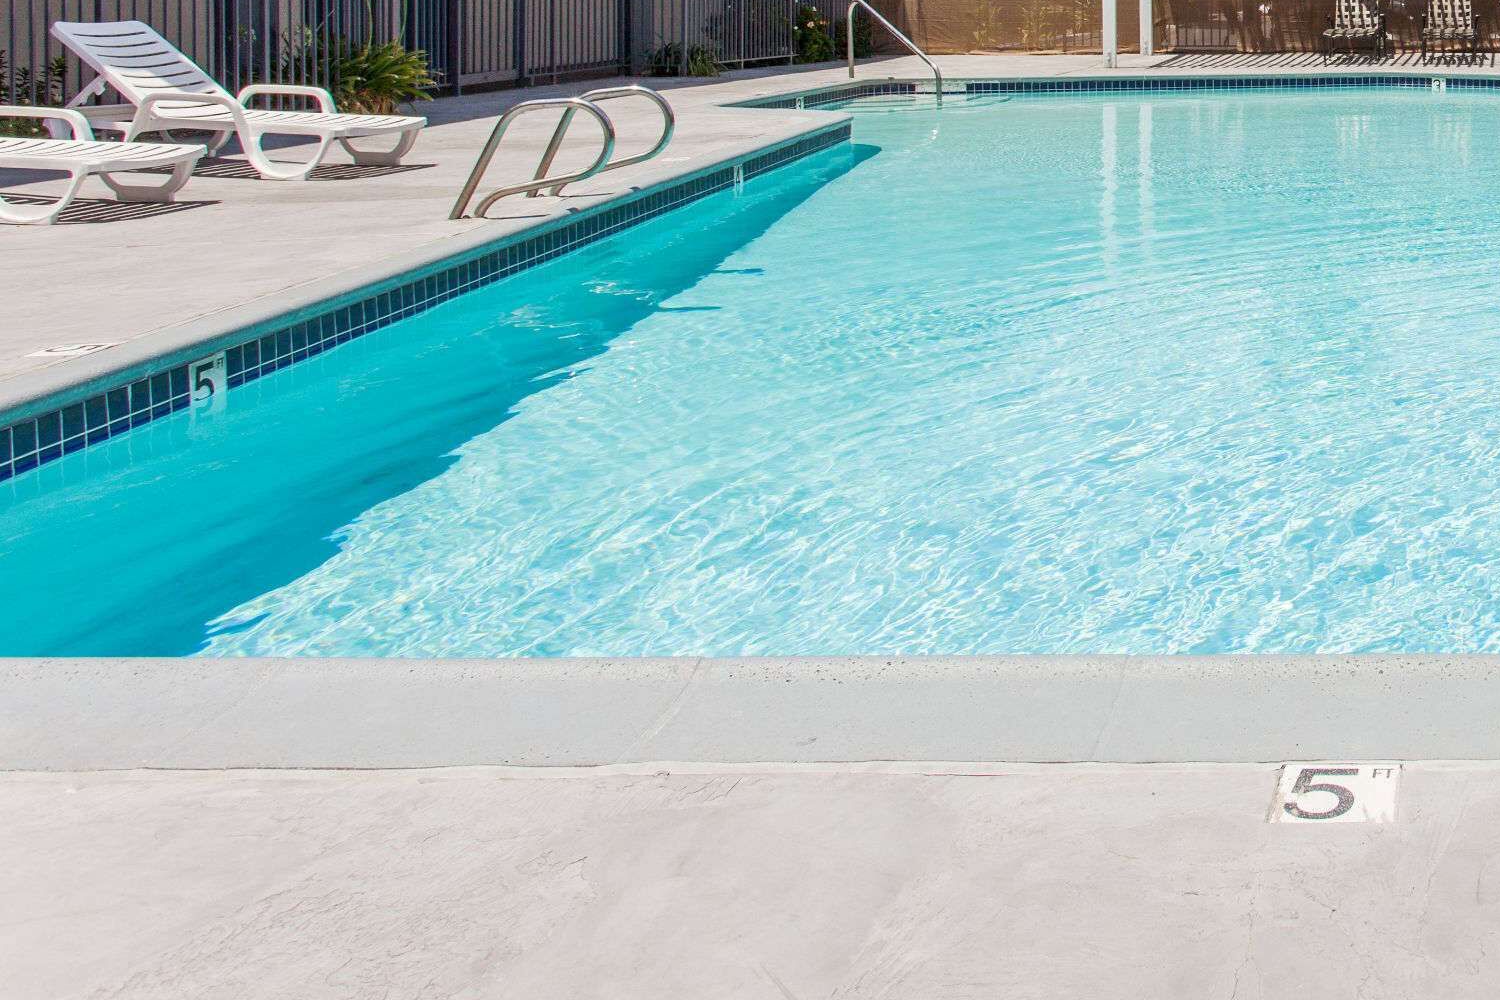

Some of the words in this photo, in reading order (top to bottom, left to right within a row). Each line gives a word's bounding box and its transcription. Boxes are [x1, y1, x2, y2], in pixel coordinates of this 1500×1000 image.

[194, 360, 215, 402] 5
[1283, 768, 1360, 820] 5
[1372, 768, 1396, 779] FT
